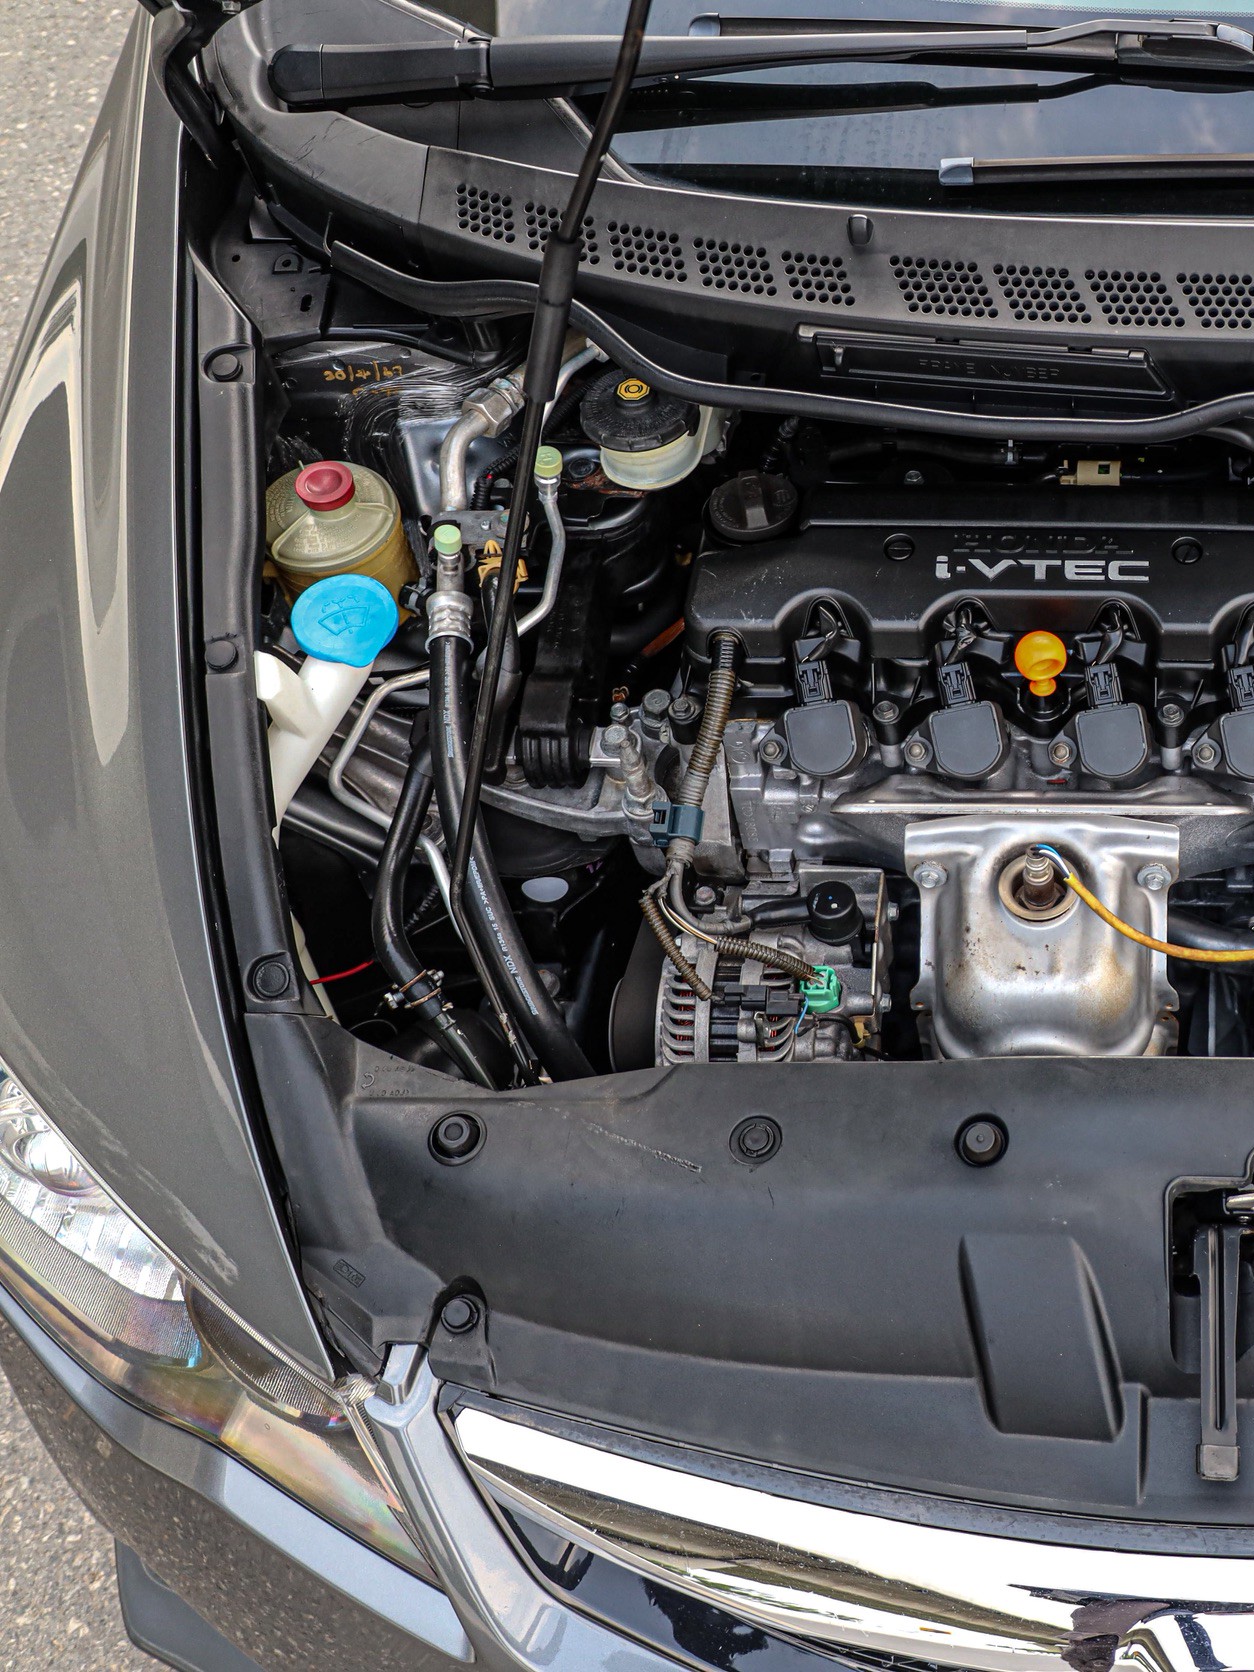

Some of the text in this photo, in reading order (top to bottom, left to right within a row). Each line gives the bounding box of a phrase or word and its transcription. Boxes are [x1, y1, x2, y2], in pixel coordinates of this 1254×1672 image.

[952, 534, 1134, 555] HONDA
[935, 555, 1150, 582] i-VTEC
[485, 906, 496, 922] SUC
[503, 954, 518, 975] NDX
